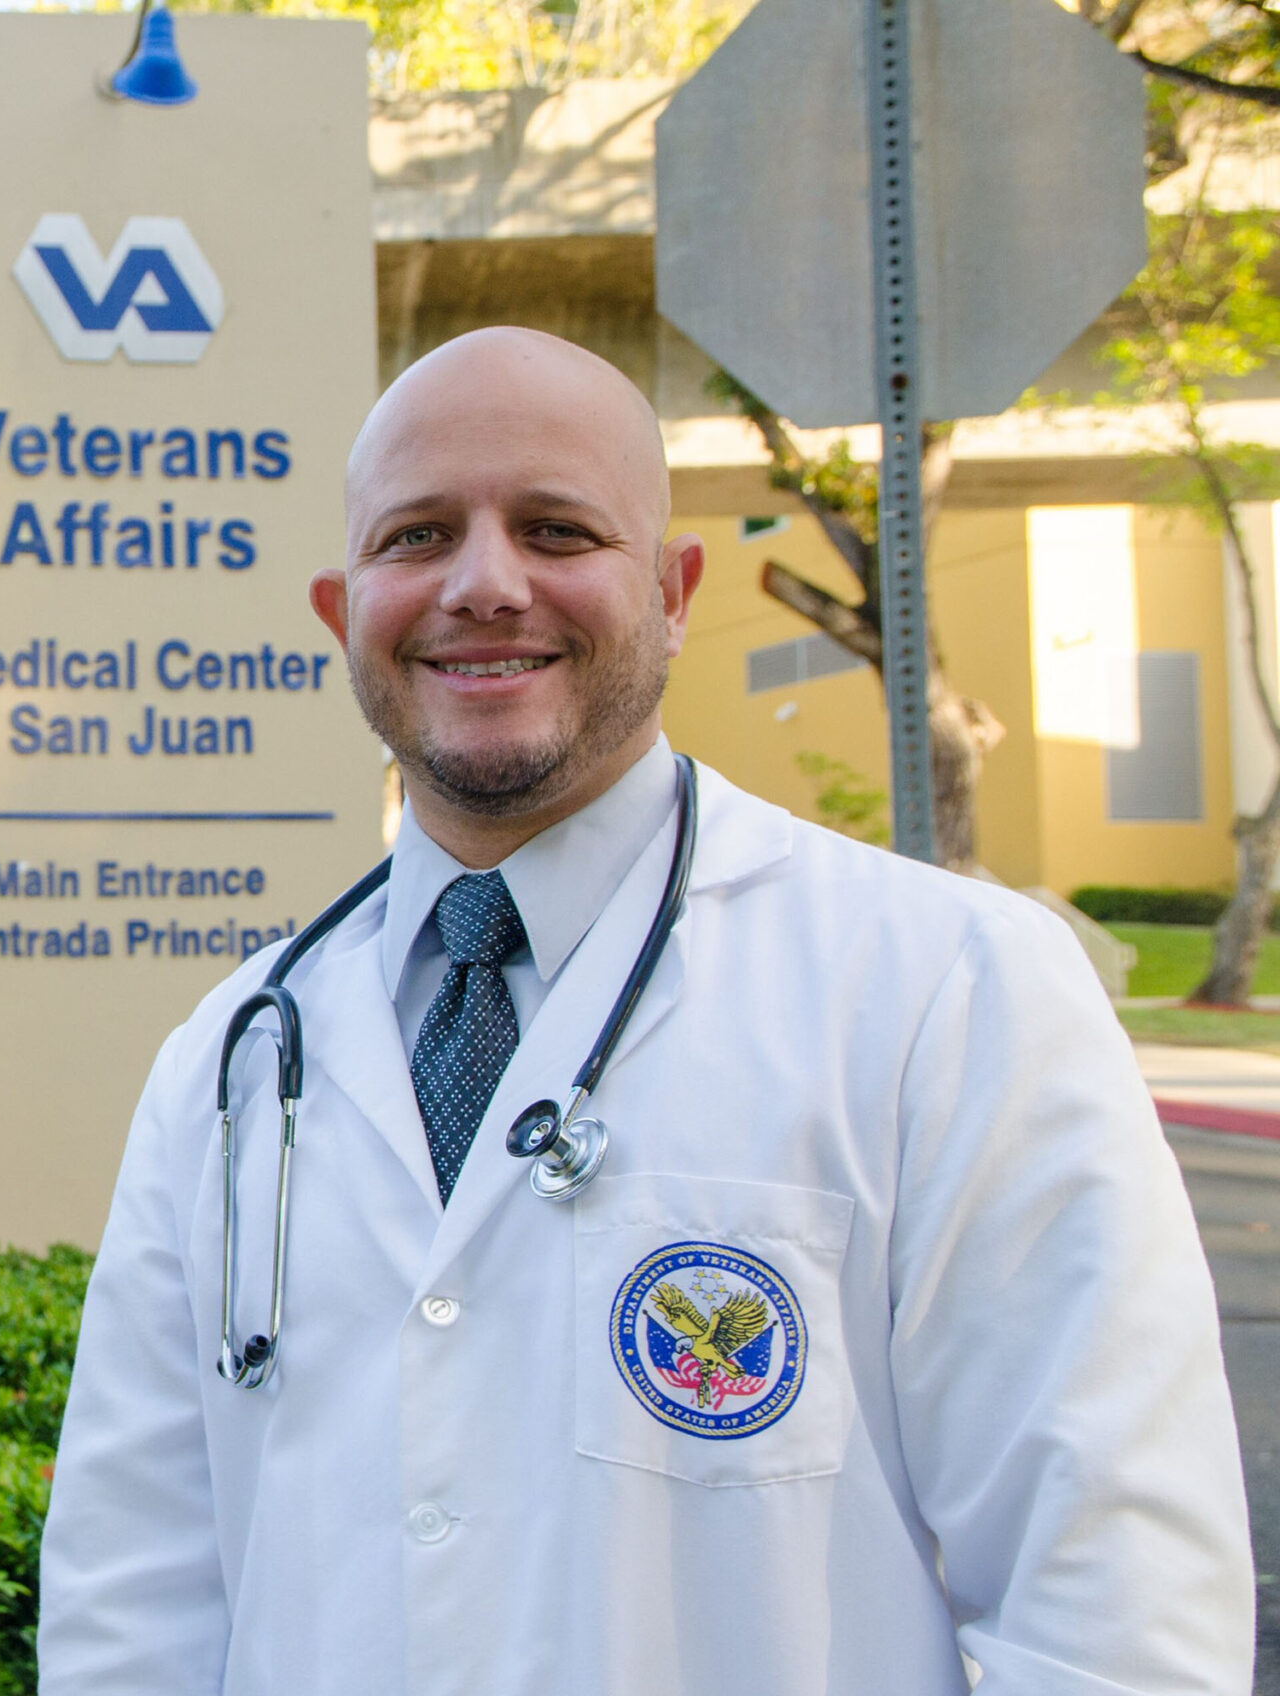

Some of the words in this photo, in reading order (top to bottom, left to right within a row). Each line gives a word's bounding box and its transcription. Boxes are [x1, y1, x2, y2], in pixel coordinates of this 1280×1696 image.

[33, 245, 214, 332] VA
[0, 500, 258, 570] Affairs
[156, 638, 330, 690] Center
[12, 705, 108, 753] San
[128, 706, 253, 755] Juan
[98, 861, 265, 896] Entrance
[623, 1260, 673, 1335] DEPARTMENT
[678, 1255, 695, 1266] OF
[701, 1254, 771, 1291] VETERANS
[772, 1293, 797, 1347] AFFAIRS
[632, 1364, 663, 1406] UNITED
[666, 1404, 716, 1428] STATES
[721, 1418, 739, 1428] OF
[744, 1380, 792, 1423] AMERICA
